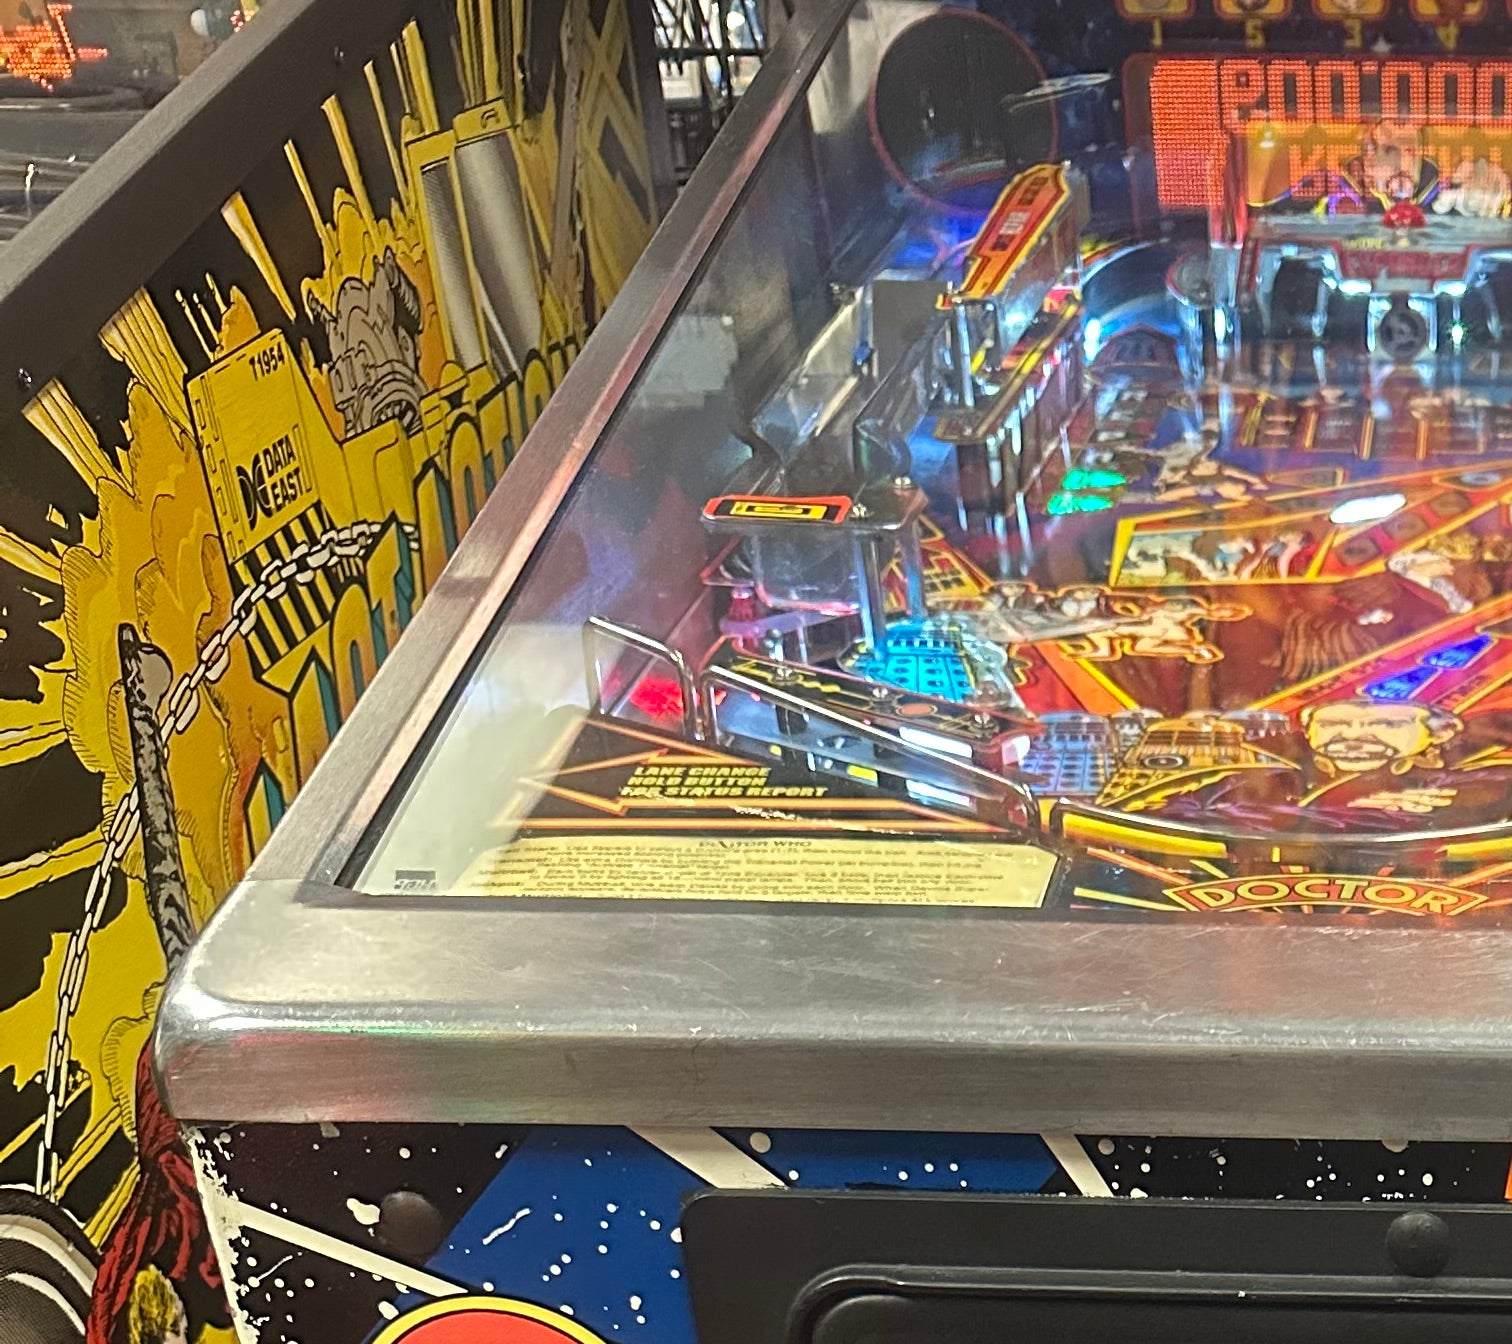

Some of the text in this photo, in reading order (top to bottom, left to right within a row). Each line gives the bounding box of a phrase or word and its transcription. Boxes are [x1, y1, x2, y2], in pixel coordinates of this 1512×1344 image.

[249, 341, 285, 381] T1954
[263, 434, 297, 479] DATA
[270, 466, 305, 512] EAST
[627, 776, 769, 787] HOLD BUTTON
[634, 766, 772, 777] LANE CHANGE
[619, 786, 829, 797] FOR STATUS REPORT
[1189, 878, 1461, 914] DOCTOR
